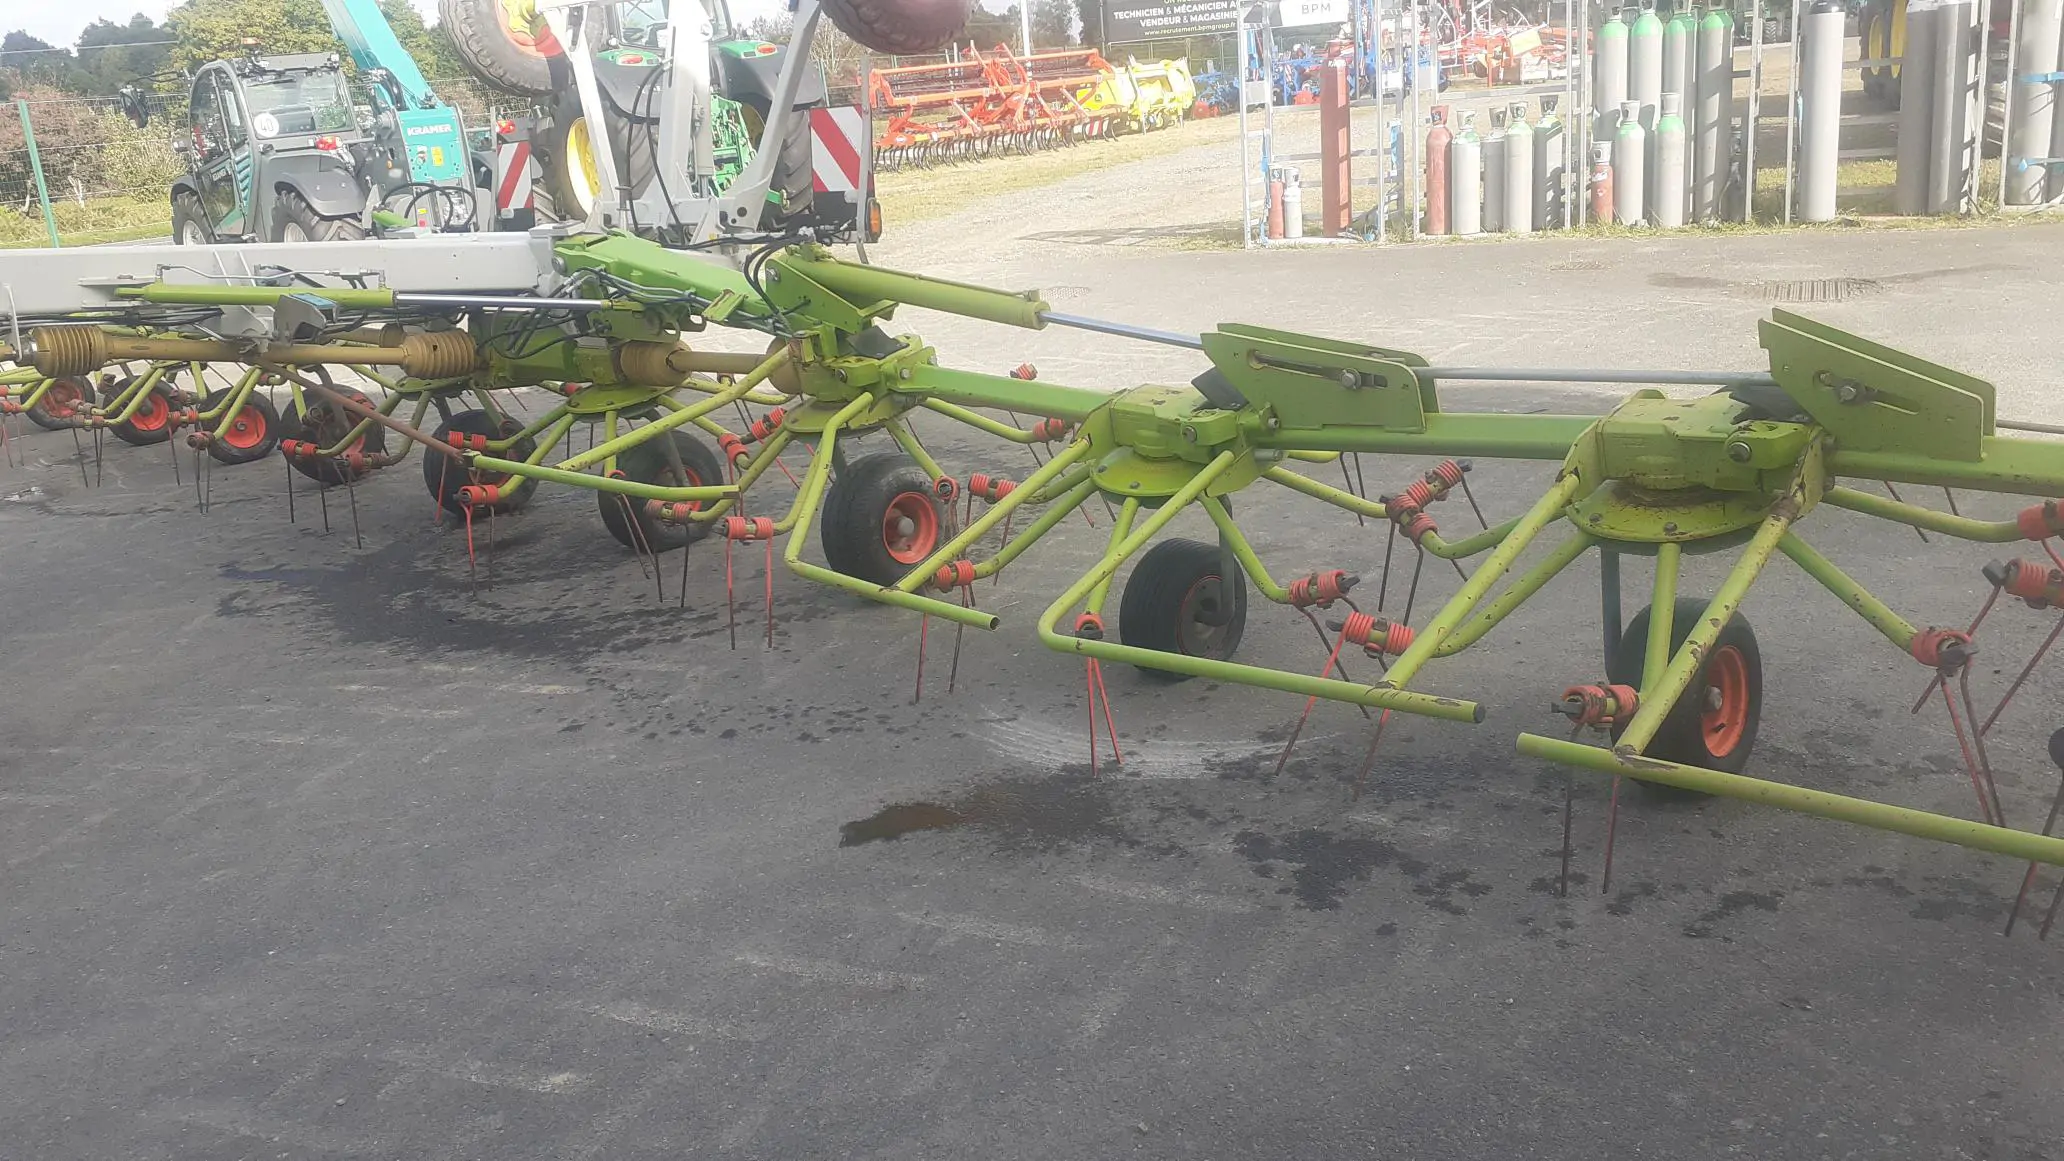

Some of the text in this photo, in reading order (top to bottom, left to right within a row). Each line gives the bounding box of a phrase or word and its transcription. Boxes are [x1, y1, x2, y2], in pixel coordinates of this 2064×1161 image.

[1113, 7, 1164, 20] TECHNICIEN
[1166, 6, 1172, 15] &
[1173, 1, 1228, 14] MÉCANICIEN
[1301, 3, 1331, 15] BPM
[1140, 10, 1238, 27] VENDEUR & MAGASINIE
[1144, 21, 1237, 36] www.recrutement.bpmgroup.fr
[407, 123, 452, 136] KRAMER
